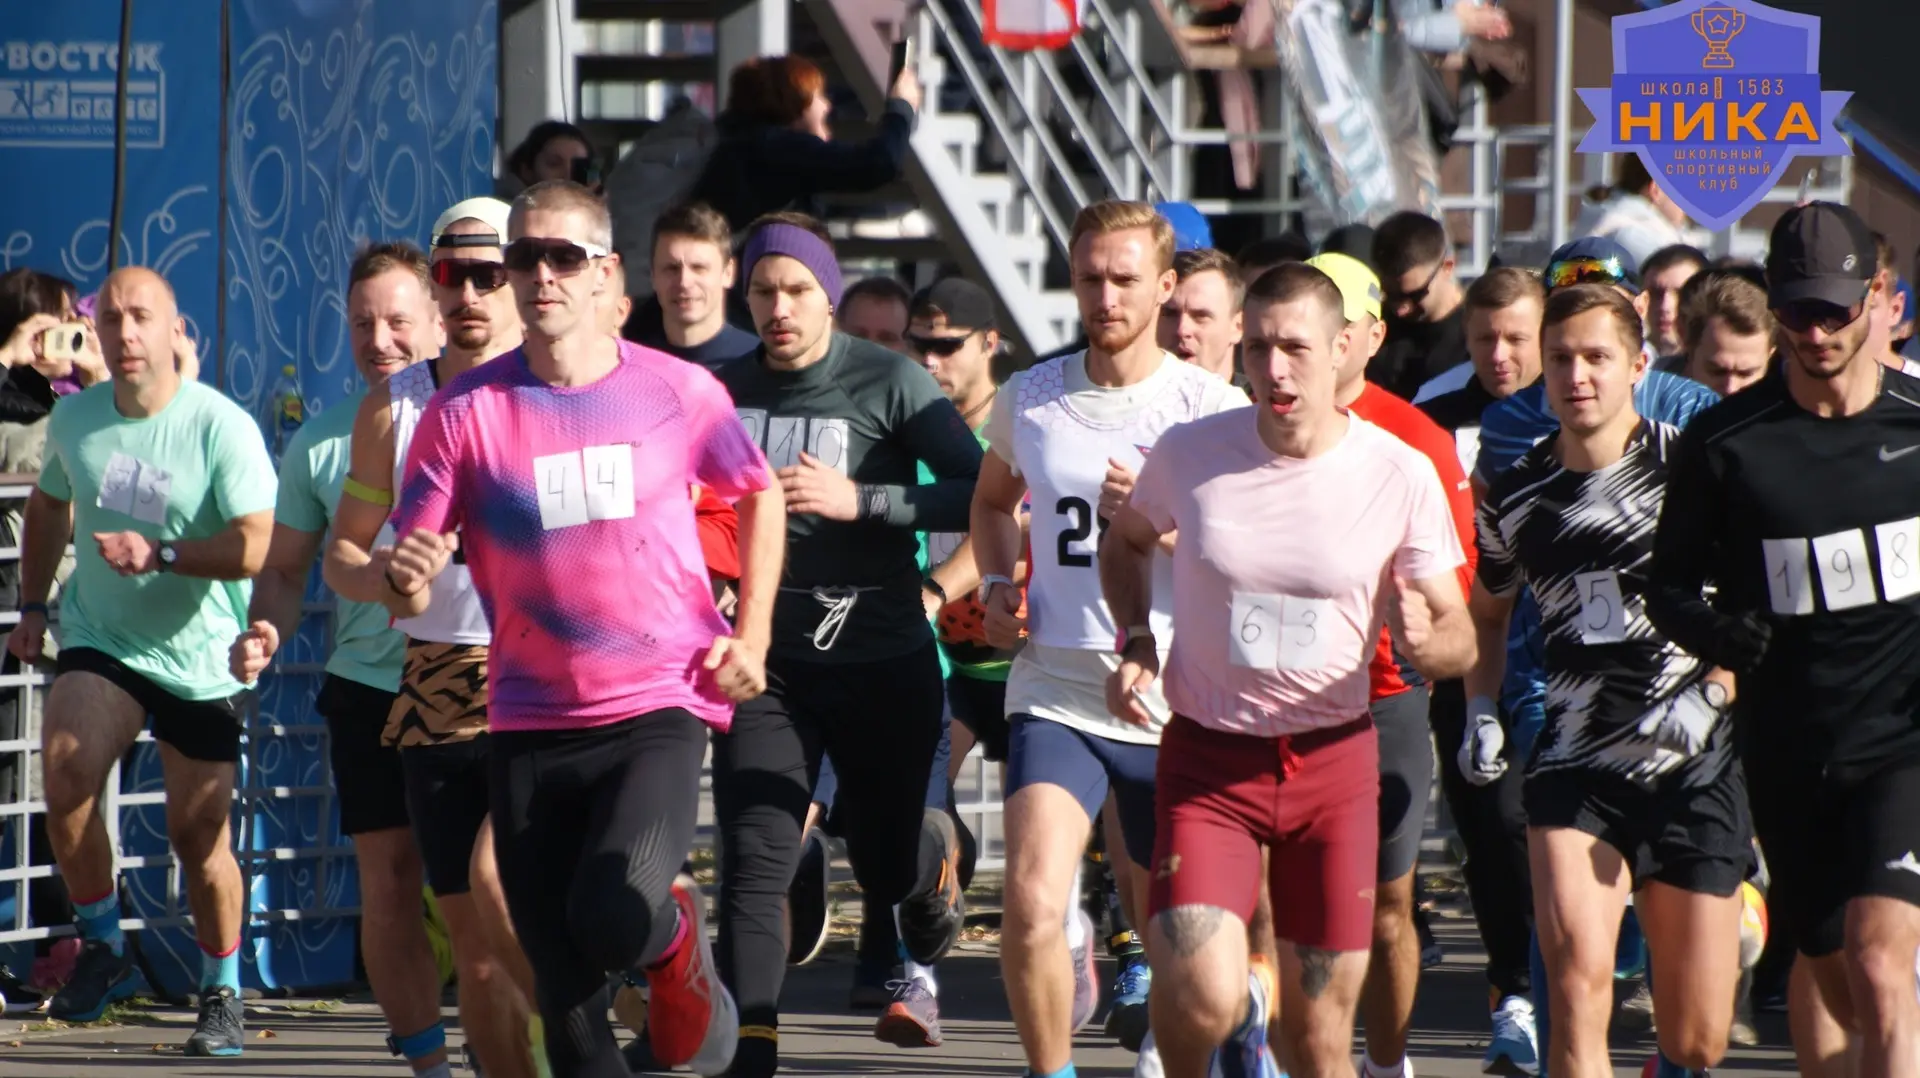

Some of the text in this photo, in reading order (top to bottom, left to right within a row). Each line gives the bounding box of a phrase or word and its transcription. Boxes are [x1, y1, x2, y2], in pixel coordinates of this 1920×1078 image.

[0, 42, 162, 72] ВОСТОК
[547, 460, 616, 511] 44
[1056, 496, 1109, 567] 2
[1241, 605, 1317, 648] 63
[1588, 578, 1611, 631] 5
